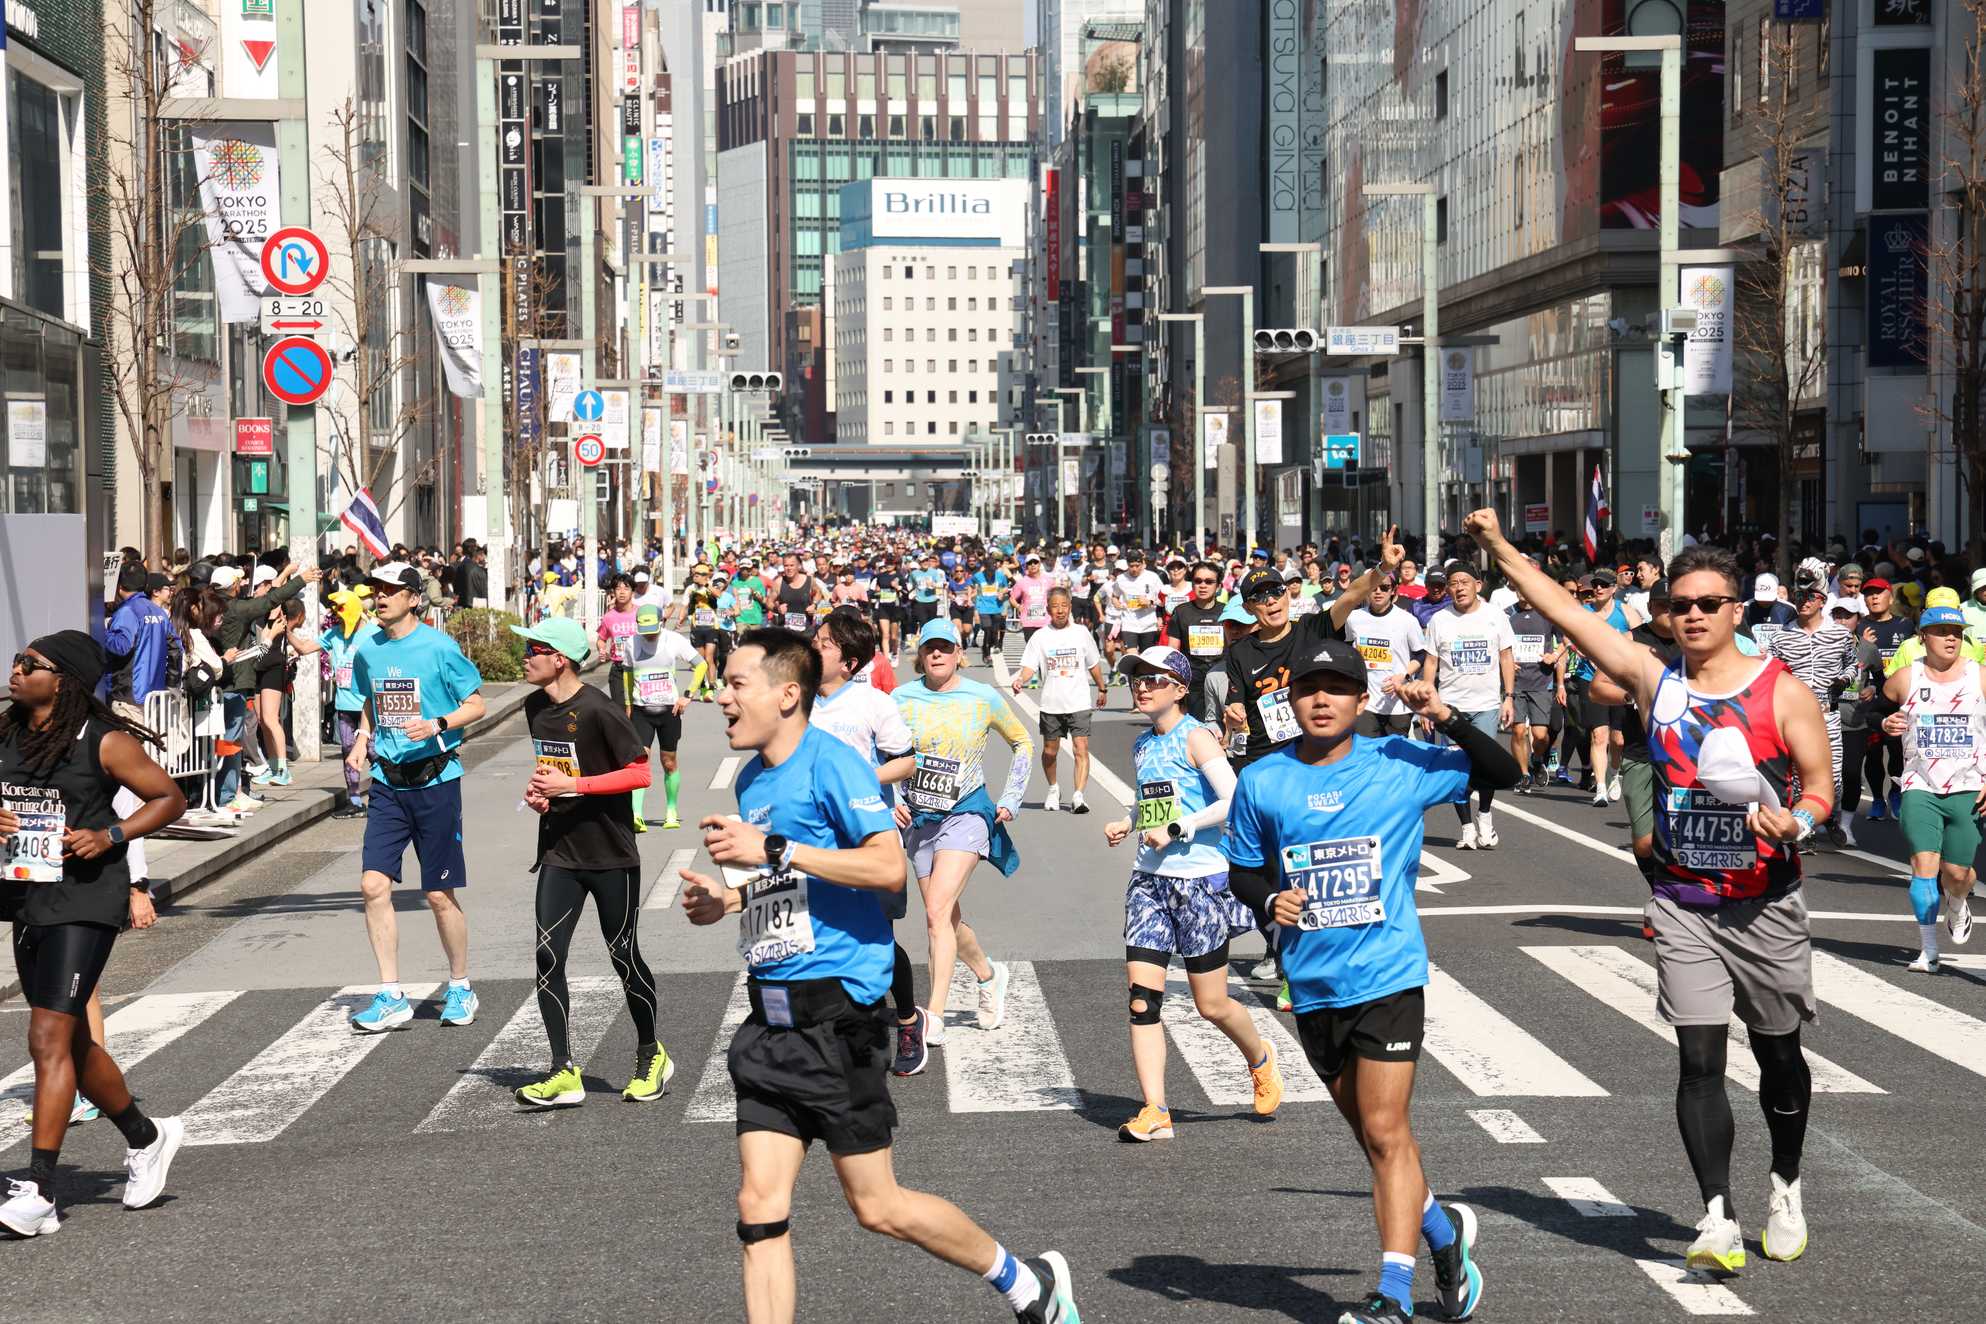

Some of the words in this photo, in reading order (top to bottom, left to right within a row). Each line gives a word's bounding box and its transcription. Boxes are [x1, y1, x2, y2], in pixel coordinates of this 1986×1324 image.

[1884, 78, 1899, 182] BENOIT
[1904, 77, 1918, 181] NIHANT
[217, 196, 267, 208] TOKYO
[884, 192, 991, 214] Brillia
[221, 219, 268, 235] 2025
[518, 273, 528, 321] PILATES
[1881, 270, 1897, 340] ROYAL
[1697, 312, 1725, 321] OKYO
[440, 320, 473, 329] TOKYO
[1690, 327, 1725, 337] 2025
[1331, 334, 1394, 346] 銀座三丁目
[238, 424, 271, 433] BOOKS
[581, 444, 599, 457] 50
[1363, 648, 1387, 660] 42045
[387, 666, 402, 677] We
[1936, 716, 1968, 726] 東京メトロ
[1929, 727, 1967, 744] 47823
[543, 744, 569, 754] 東京メトロ
[925, 758, 958, 772] 東京メトロ
[1, 781, 60, 799] Koreatown
[917, 774, 953, 794] 16668
[1307, 790, 1343, 801] POCARI
[1308, 798, 1340, 808] SWEAT
[40, 799, 66, 816] Club
[1683, 815, 1744, 842] 44758
[1314, 844, 1369, 861] 東京メトロ
[754, 875, 793, 894] 東京メトロ
[1308, 865, 1371, 900] 47295
